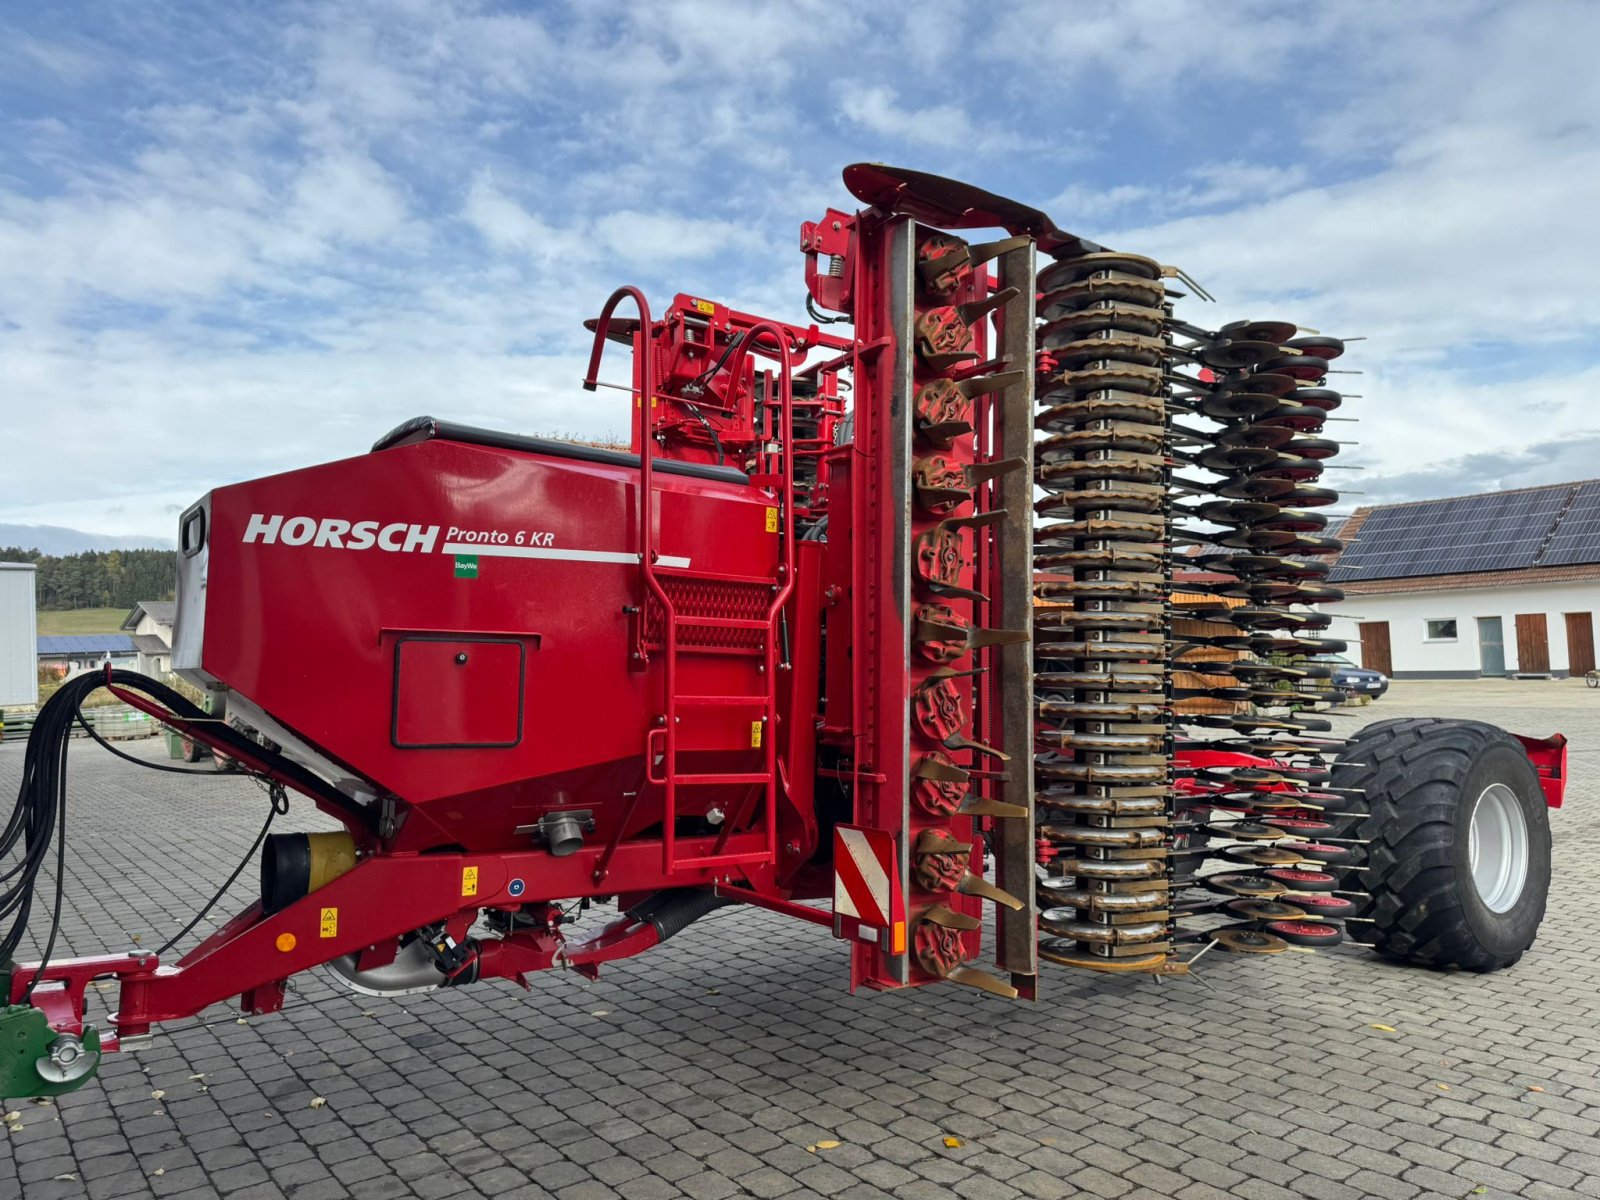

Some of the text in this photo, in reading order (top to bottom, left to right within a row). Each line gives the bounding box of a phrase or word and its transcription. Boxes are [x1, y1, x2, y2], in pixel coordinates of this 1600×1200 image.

[242, 513, 555, 553] HORSCH Pronto 6 KR
[455, 561, 477, 570] BayWa
